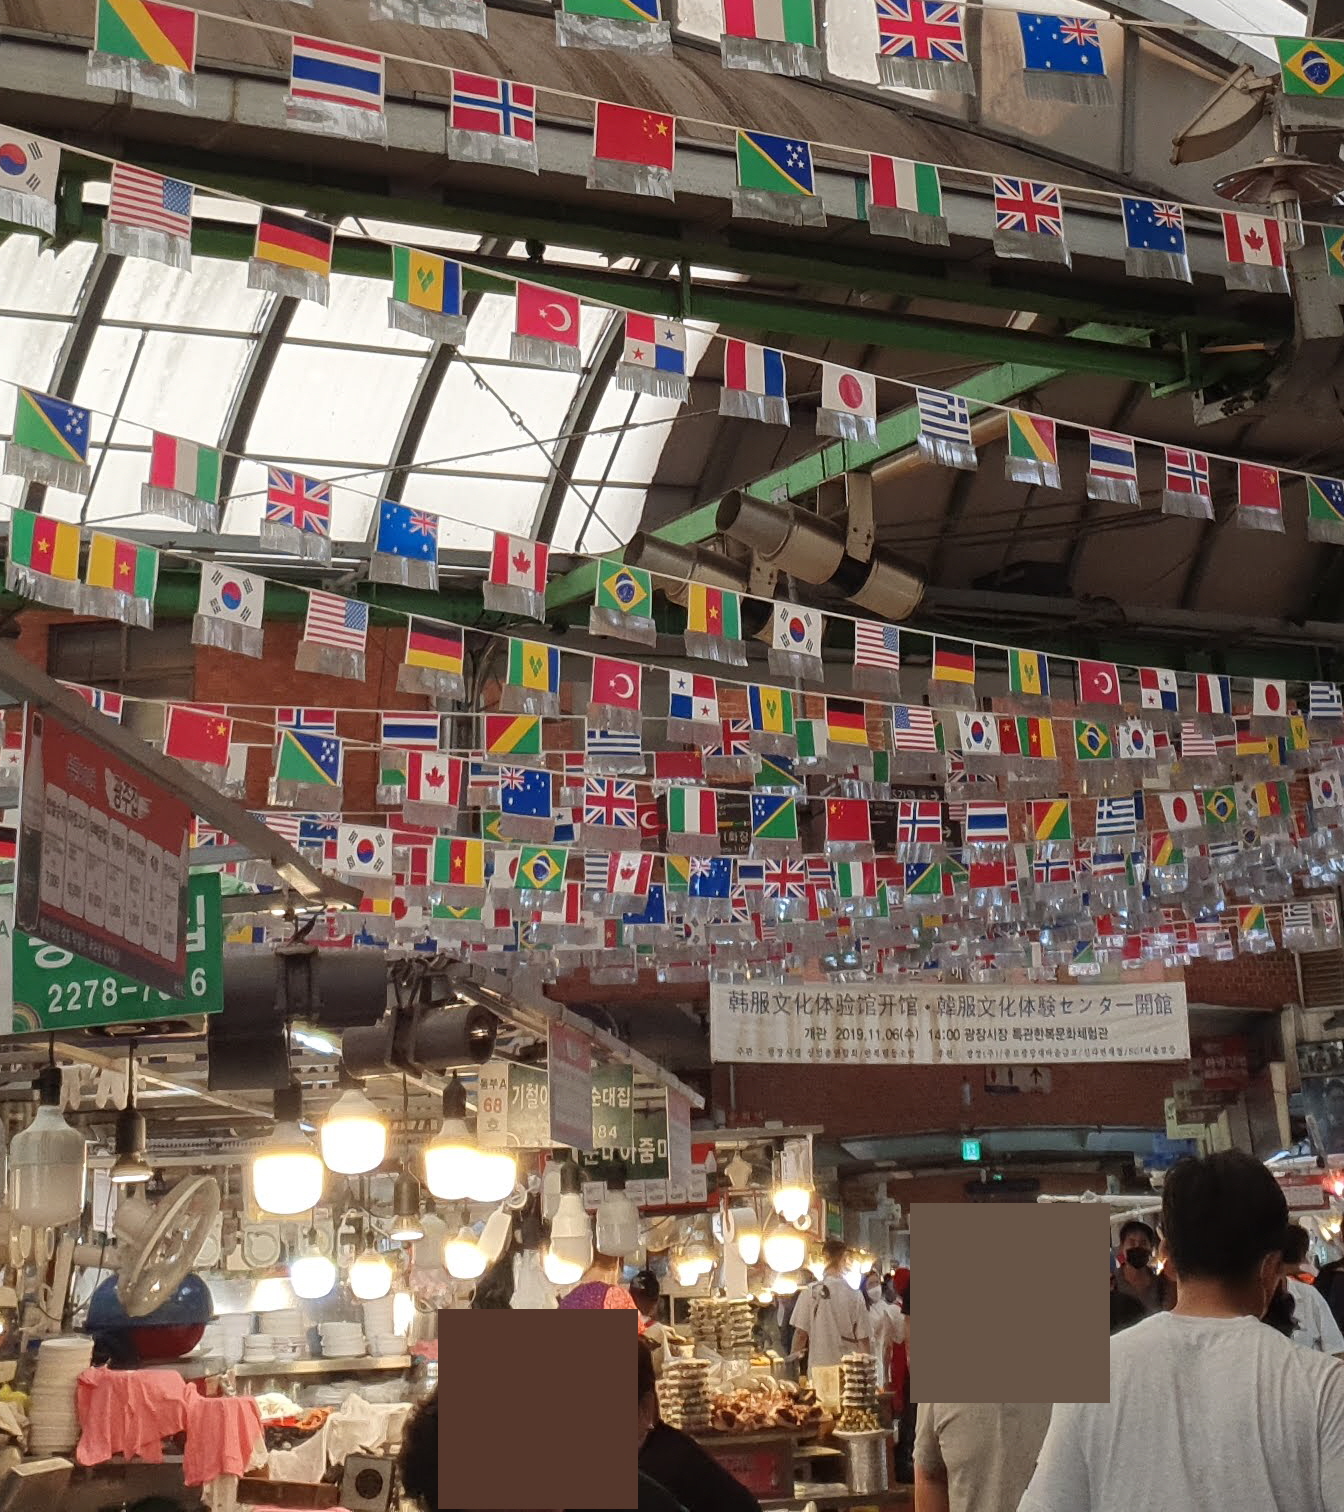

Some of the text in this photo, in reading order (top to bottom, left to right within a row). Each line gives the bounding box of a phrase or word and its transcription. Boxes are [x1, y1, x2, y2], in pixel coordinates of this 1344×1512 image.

[927, 1027, 961, 1043] 14:00
[964, 1027, 1008, 1042] 광장시장
[483, 1096, 503, 1113] 68
